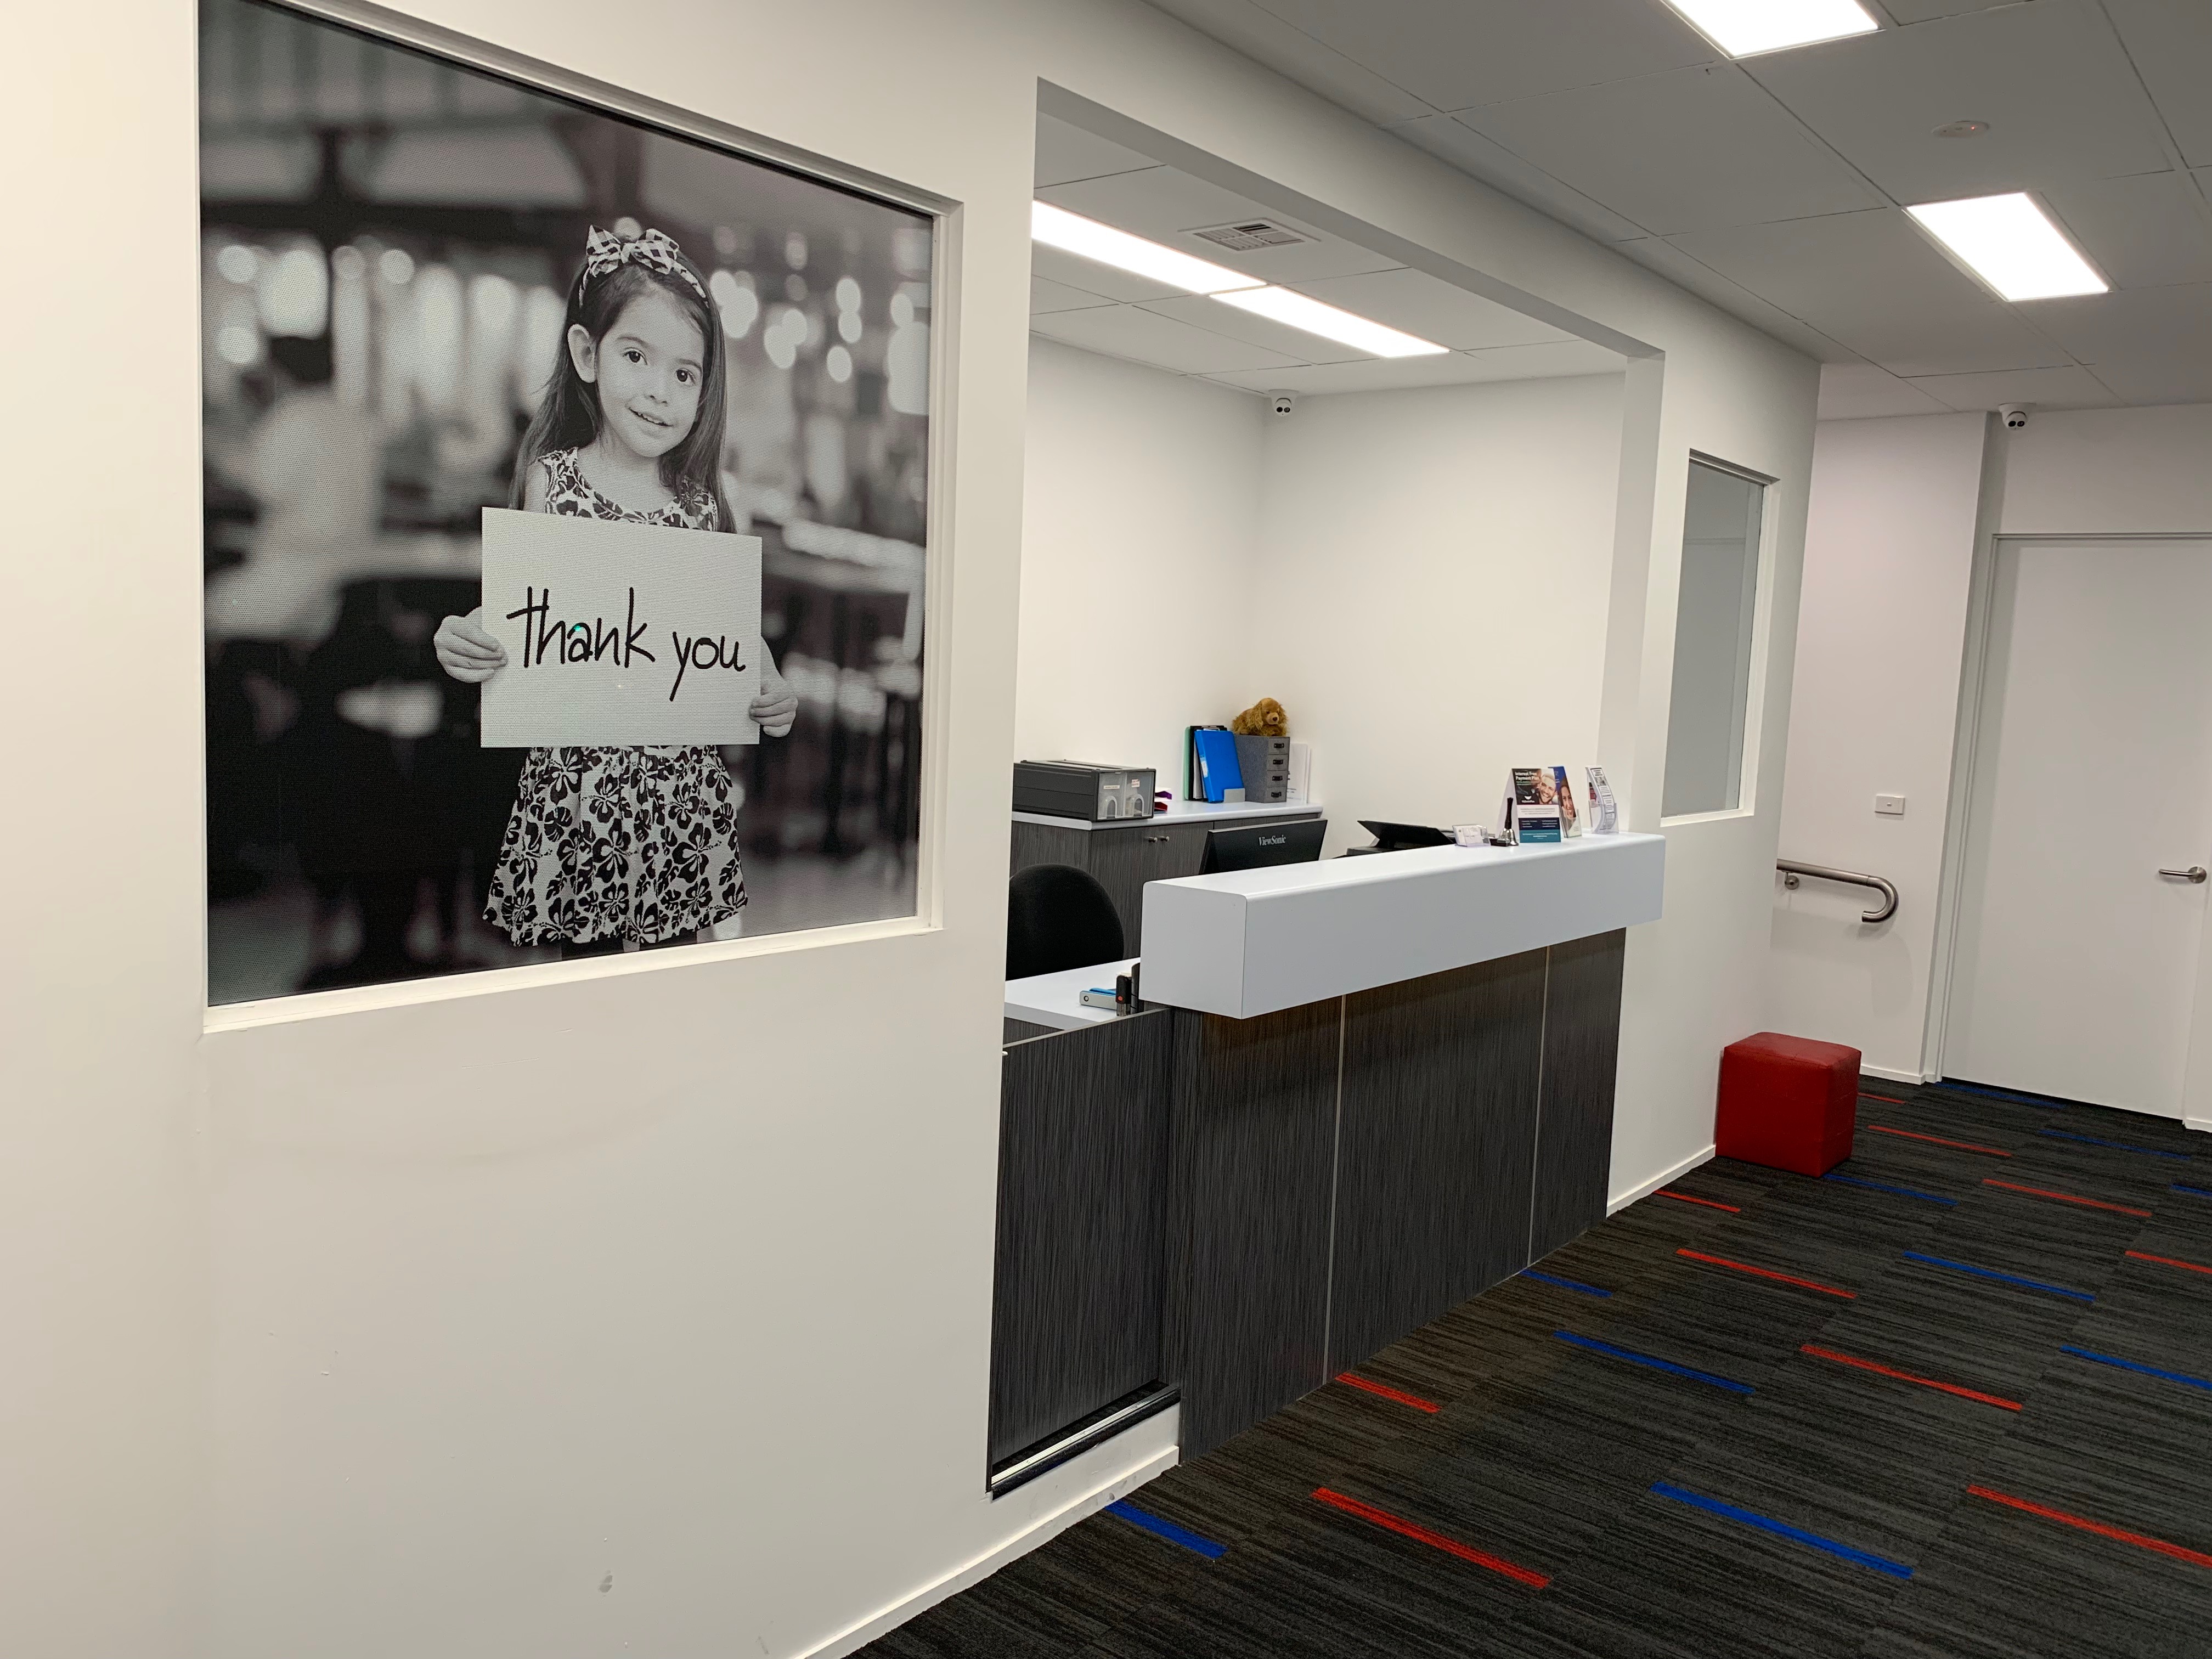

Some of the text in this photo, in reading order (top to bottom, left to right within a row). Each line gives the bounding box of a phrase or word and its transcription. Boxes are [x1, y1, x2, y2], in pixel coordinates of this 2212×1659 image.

[506, 586, 746, 702] thank you
[1259, 834, 1286, 846] ViewSonic
